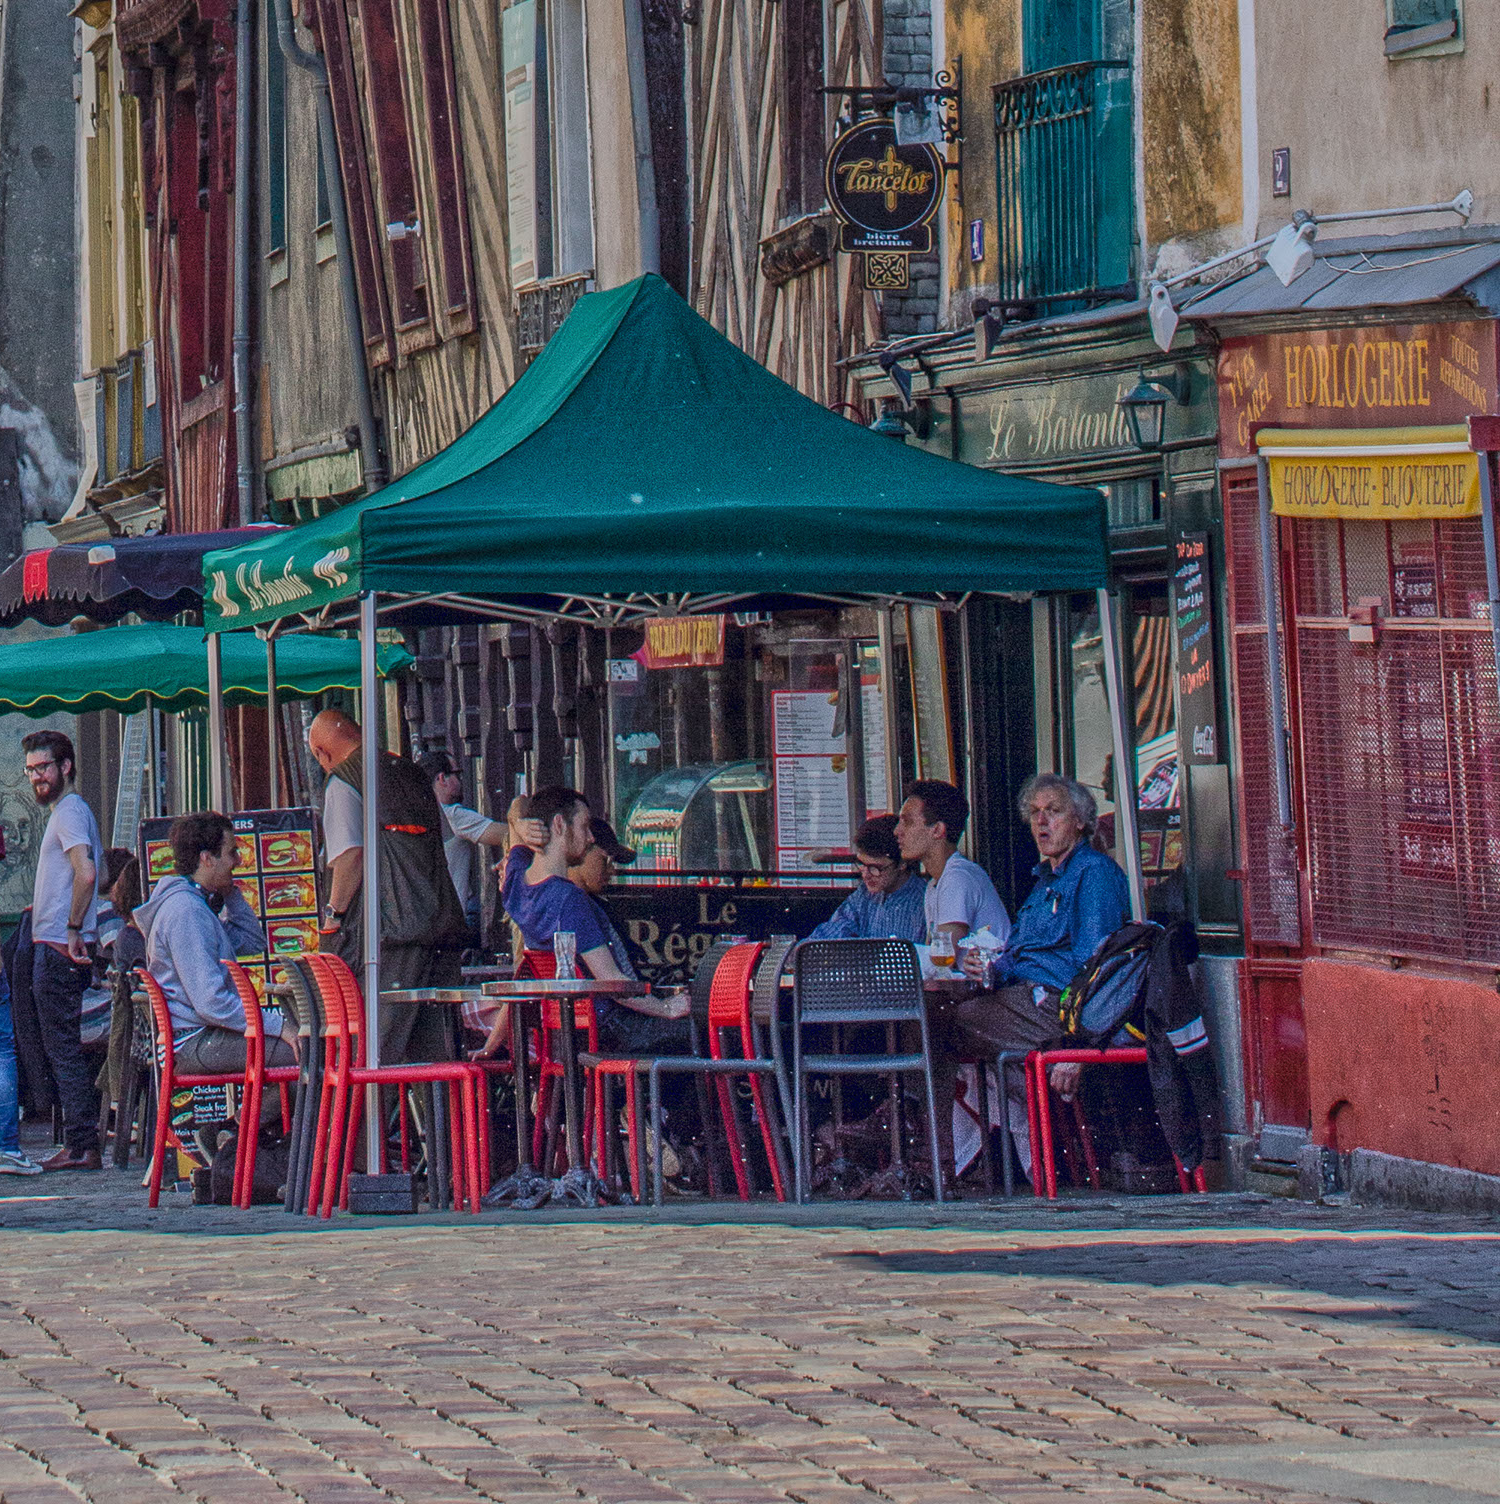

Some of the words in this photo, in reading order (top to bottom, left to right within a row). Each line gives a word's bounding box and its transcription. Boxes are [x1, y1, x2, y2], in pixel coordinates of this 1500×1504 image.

[853, 238, 912, 246] bretonne
[866, 232, 900, 240] bière
[1450, 335, 1480, 375] TOUTES
[1284, 339, 1431, 409] HORLOGERIE
[1283, 464, 1372, 508] HORLOGERIE
[1381, 463, 1467, 508] BIJOUTERIE
[698, 893, 737, 924] Le
[192, 1084, 221, 1094] Chicken
[194, 1102, 213, 1112] Steak
